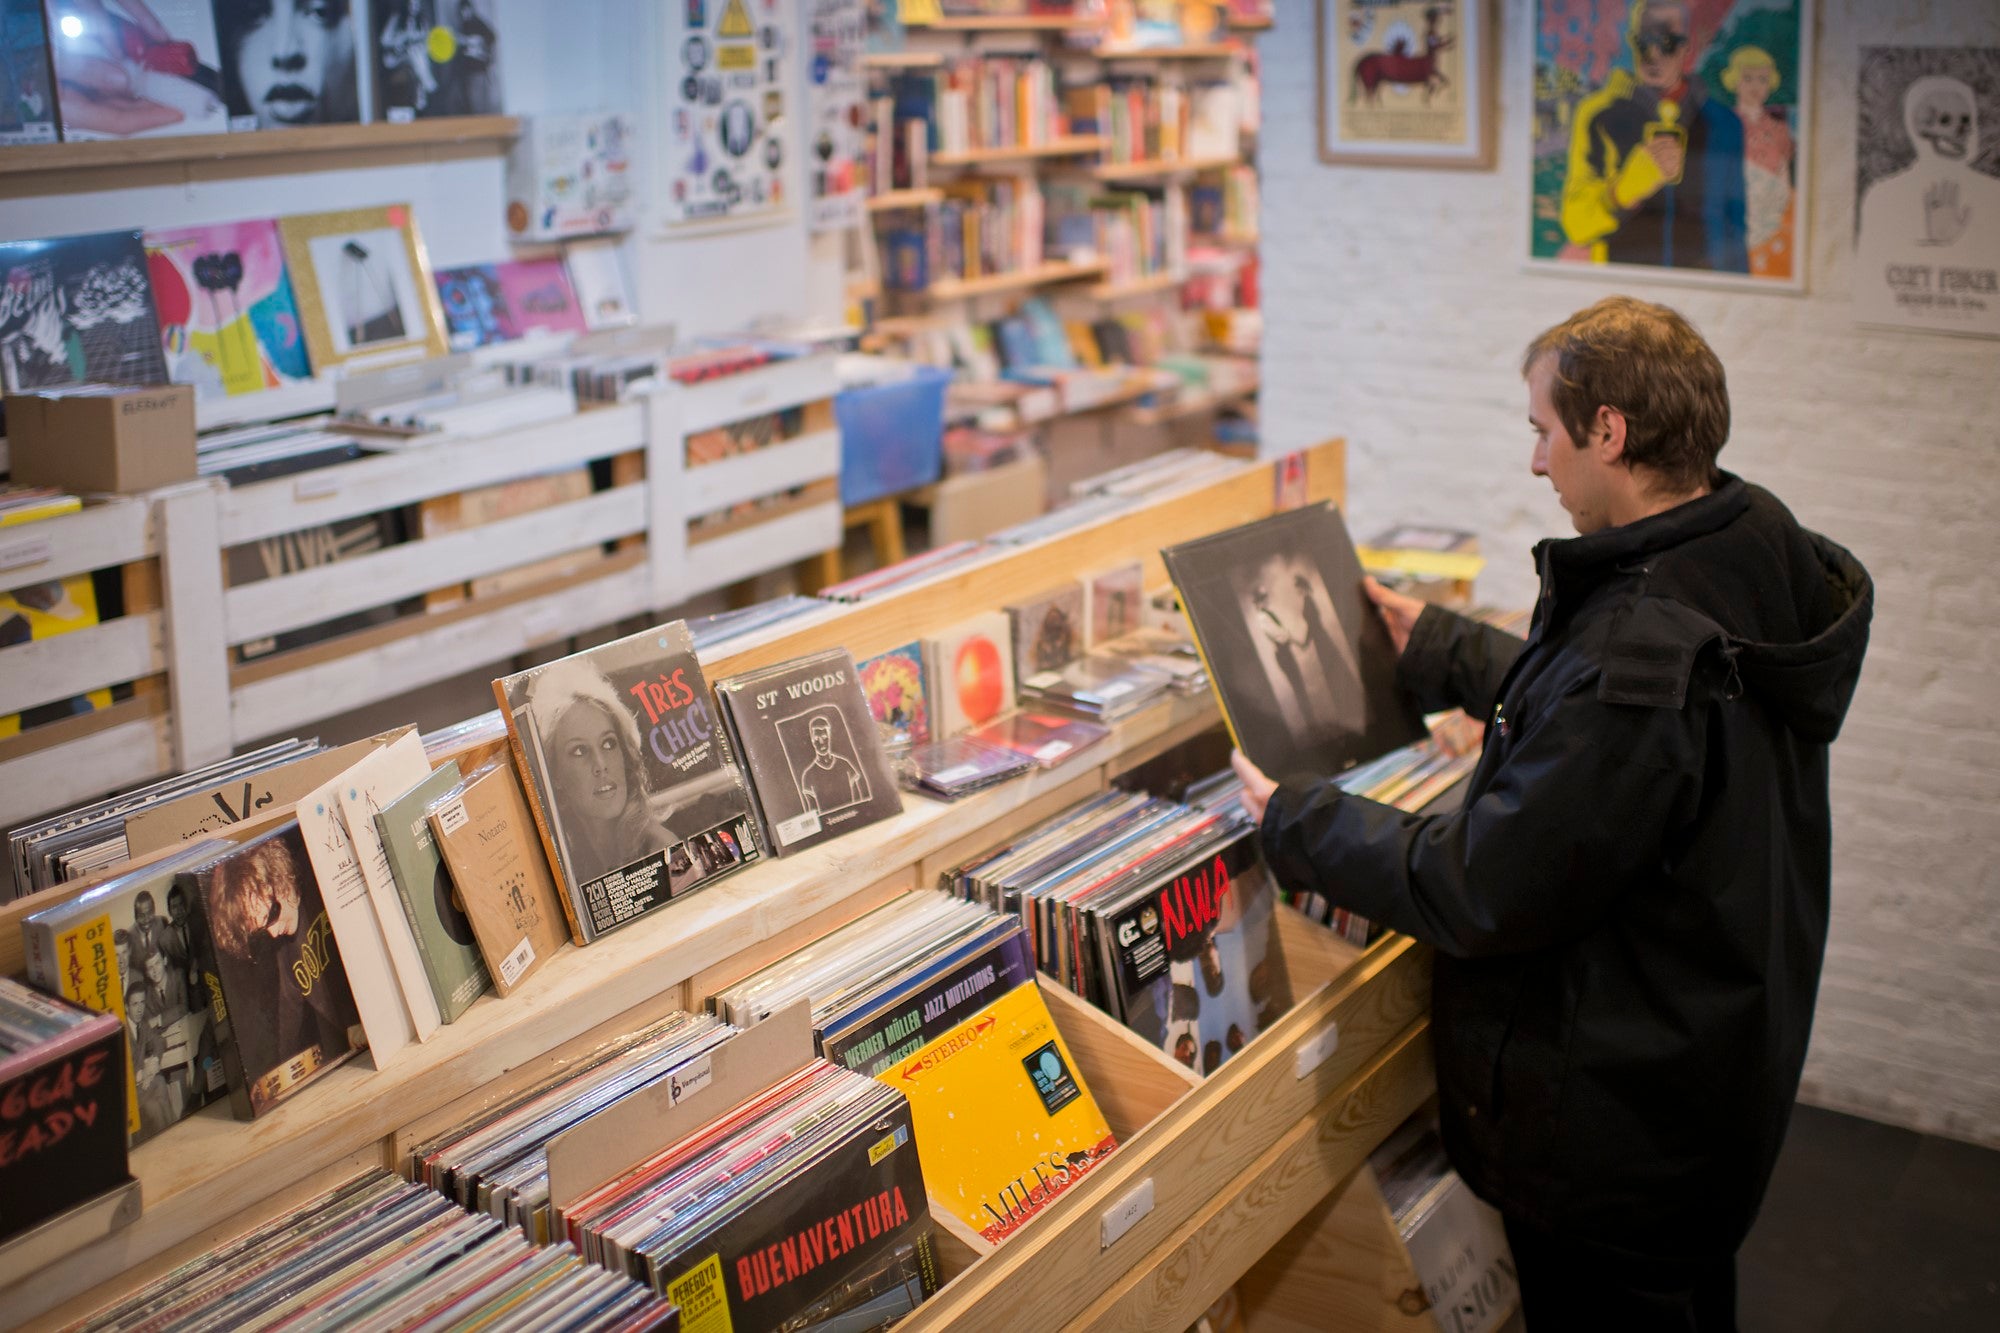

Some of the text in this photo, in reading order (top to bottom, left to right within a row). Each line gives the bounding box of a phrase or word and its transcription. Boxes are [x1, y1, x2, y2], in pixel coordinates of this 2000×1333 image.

[629, 668, 694, 725] TRÈS
[756, 670, 846, 710] ST WOODS
[649, 697, 712, 764] CHIC!
[477, 819, 508, 846] Notario
[608, 868, 658, 896] JOHNNY HALLYDAY
[625, 861, 662, 880] GAINSBOURG
[586, 881, 606, 904] 2CD
[86, 922, 106, 941] OF
[596, 914, 616, 931] BOOK
[843, 1032, 886, 1069] WERNER
[884, 1010, 922, 1047] MÜLLER
[924, 1000, 947, 1024] JAZZ
[944, 964, 996, 1010] MUTATIONS
[921, 1027, 978, 1071] STEREO
[983, 1151, 1071, 1234] MILES
[736, 1185, 909, 1302] BUENAVENTURA
[672, 1262, 717, 1305] PEREGOYO
